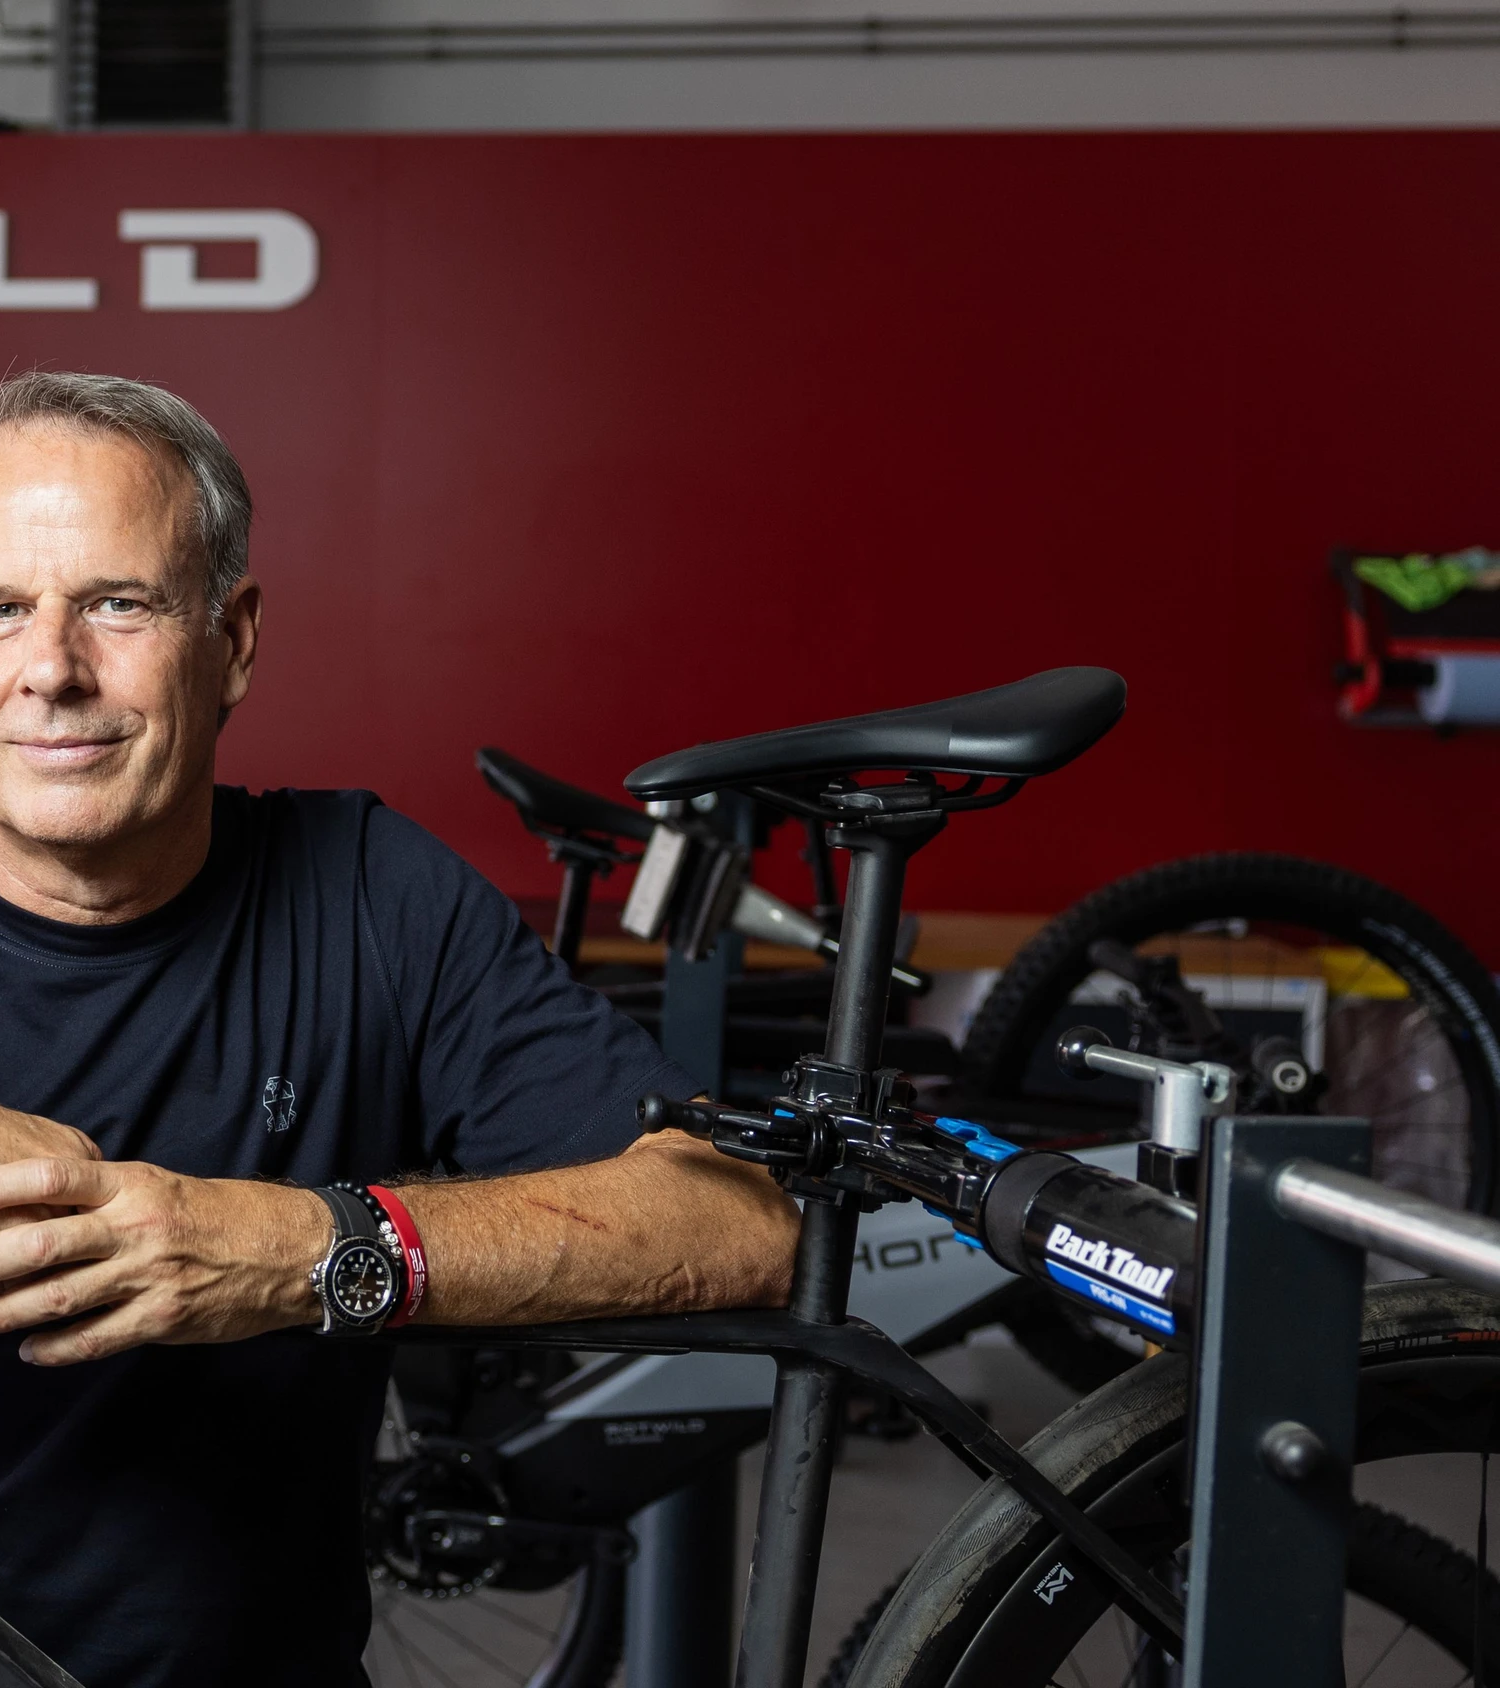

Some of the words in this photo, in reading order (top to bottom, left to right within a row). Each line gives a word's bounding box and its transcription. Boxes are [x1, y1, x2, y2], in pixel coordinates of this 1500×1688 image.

[1046, 1223, 1111, 1274] Park
[1107, 1247, 1174, 1300] Tool
[1033, 1562, 1062, 1595] NEWMEN
